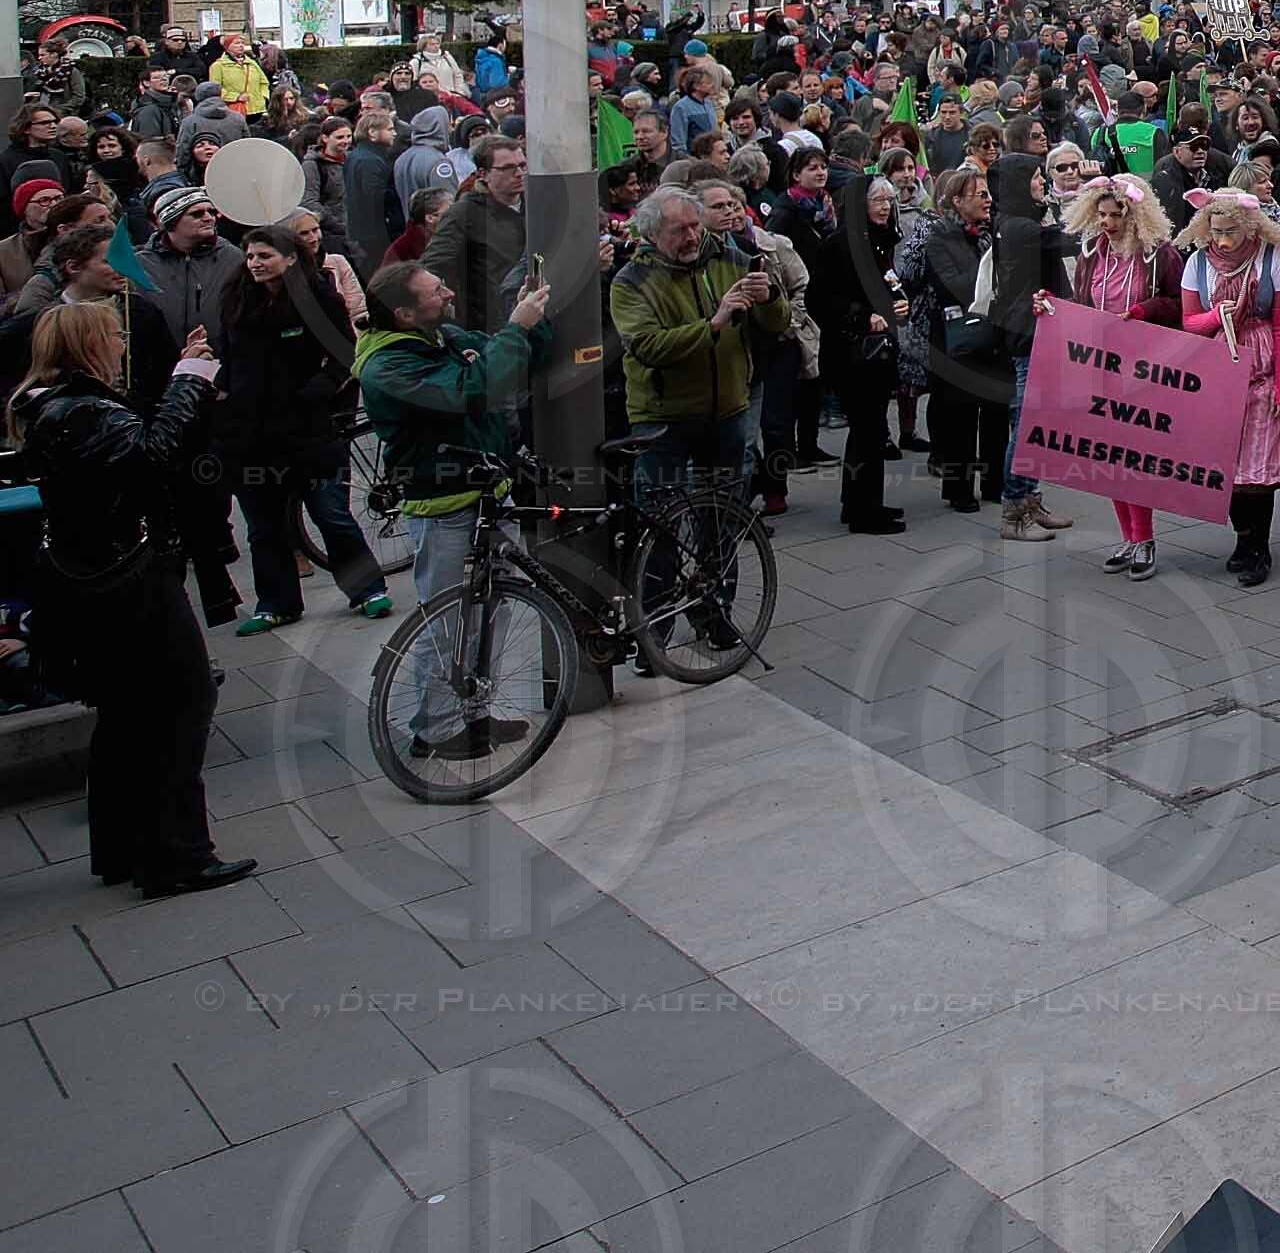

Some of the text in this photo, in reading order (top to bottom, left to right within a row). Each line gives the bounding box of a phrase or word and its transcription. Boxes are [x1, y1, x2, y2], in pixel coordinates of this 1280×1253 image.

[1067, 341, 1202, 393] WIR SIND
[1088, 395, 1173, 434] ZWAR
[1027, 426, 1225, 491] ALLESFRESSER
